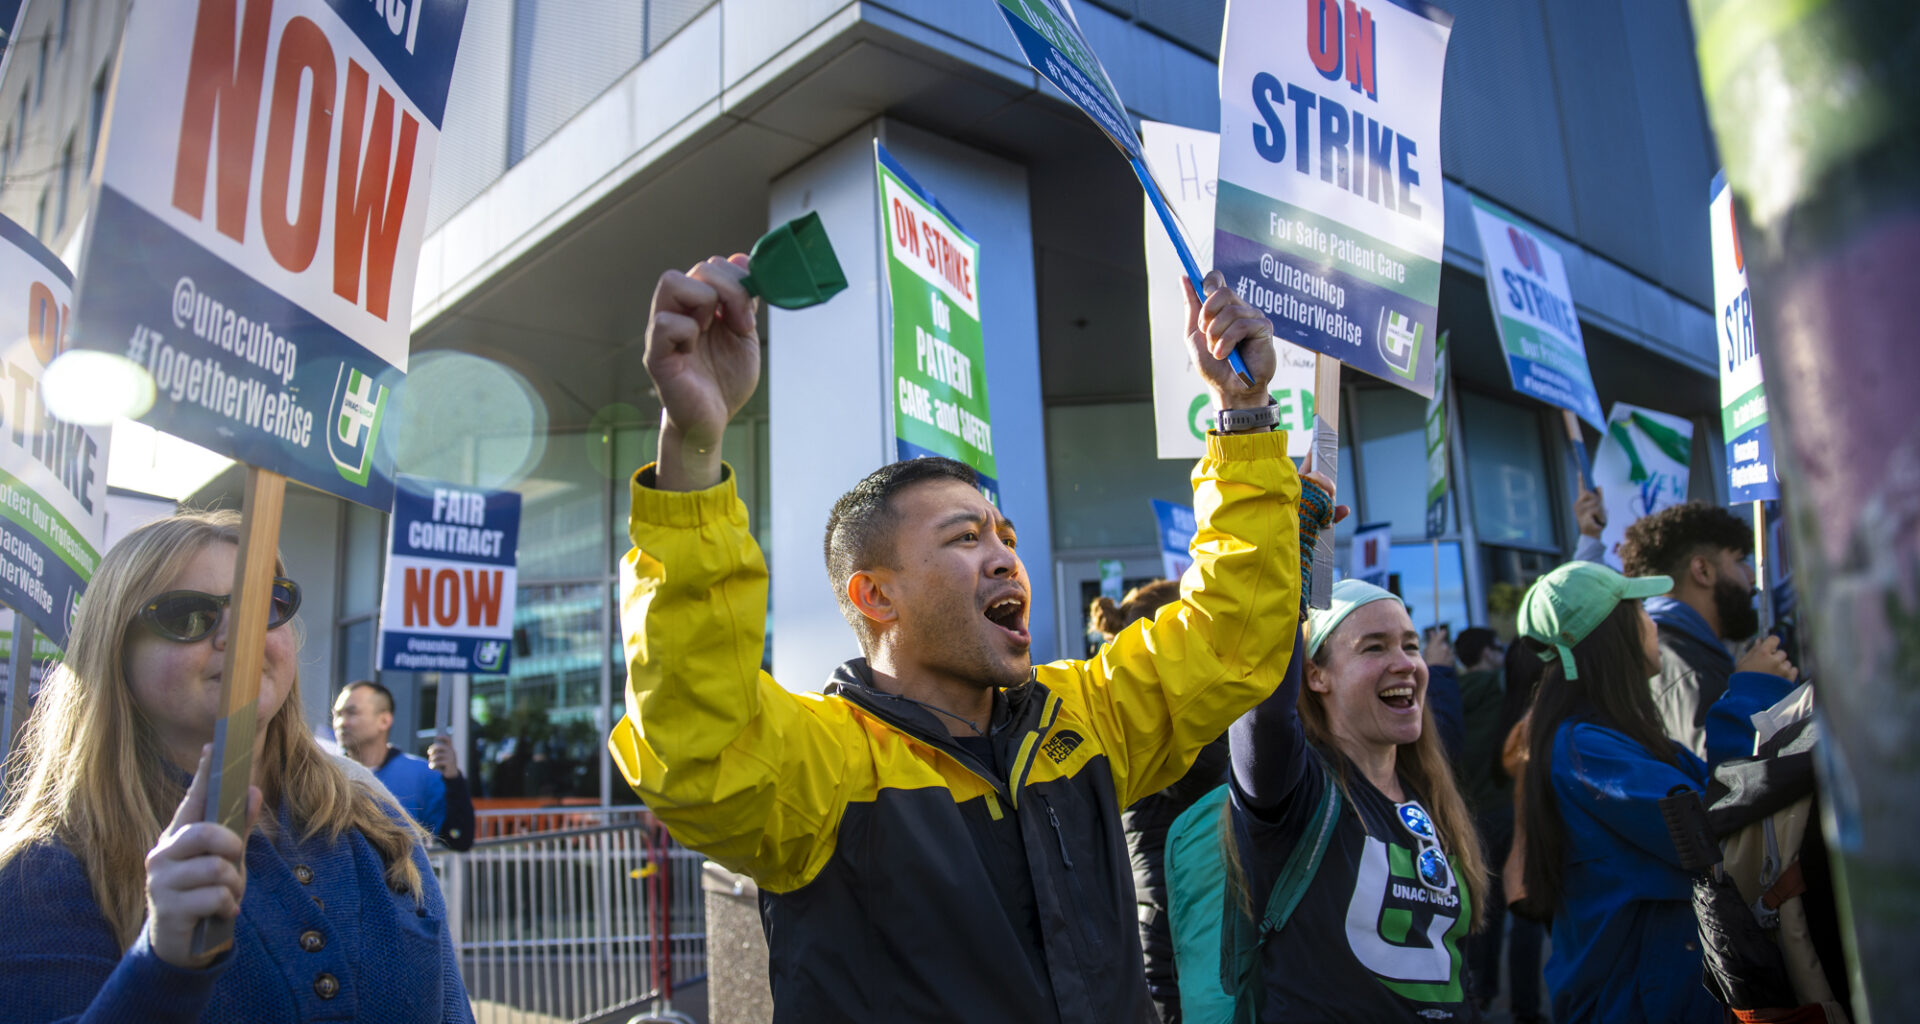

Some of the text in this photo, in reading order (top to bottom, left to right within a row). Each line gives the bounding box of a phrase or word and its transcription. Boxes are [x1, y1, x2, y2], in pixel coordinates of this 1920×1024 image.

[1307, 0, 1378, 103] ON
[171, 0, 419, 322] NOW
[1251, 71, 1422, 221] STRIKE
[893, 197, 973, 302] ON STRIKE
[1259, 252, 1345, 311] @unacuhcp
[1269, 211, 1405, 284] For Safe Patient Care
[172, 275, 298, 386] @unacuhcp
[931, 291, 950, 333] for
[1237, 274, 1363, 347] #TogetherWeRise
[1502, 267, 1579, 343] STRIKE
[126, 323, 314, 449] #TogetherWeRise
[916, 325, 973, 399] PATIENT
[0, 358, 98, 517] TRIKE
[898, 375, 993, 456] CARE and SAFETY
[32, 503, 50, 534] Our
[408, 520, 505, 558] CONTRACT
[432, 487, 486, 528] FAIR
[403, 567, 504, 627] NOW
[1392, 883, 1458, 907] UNAC/UHCP
